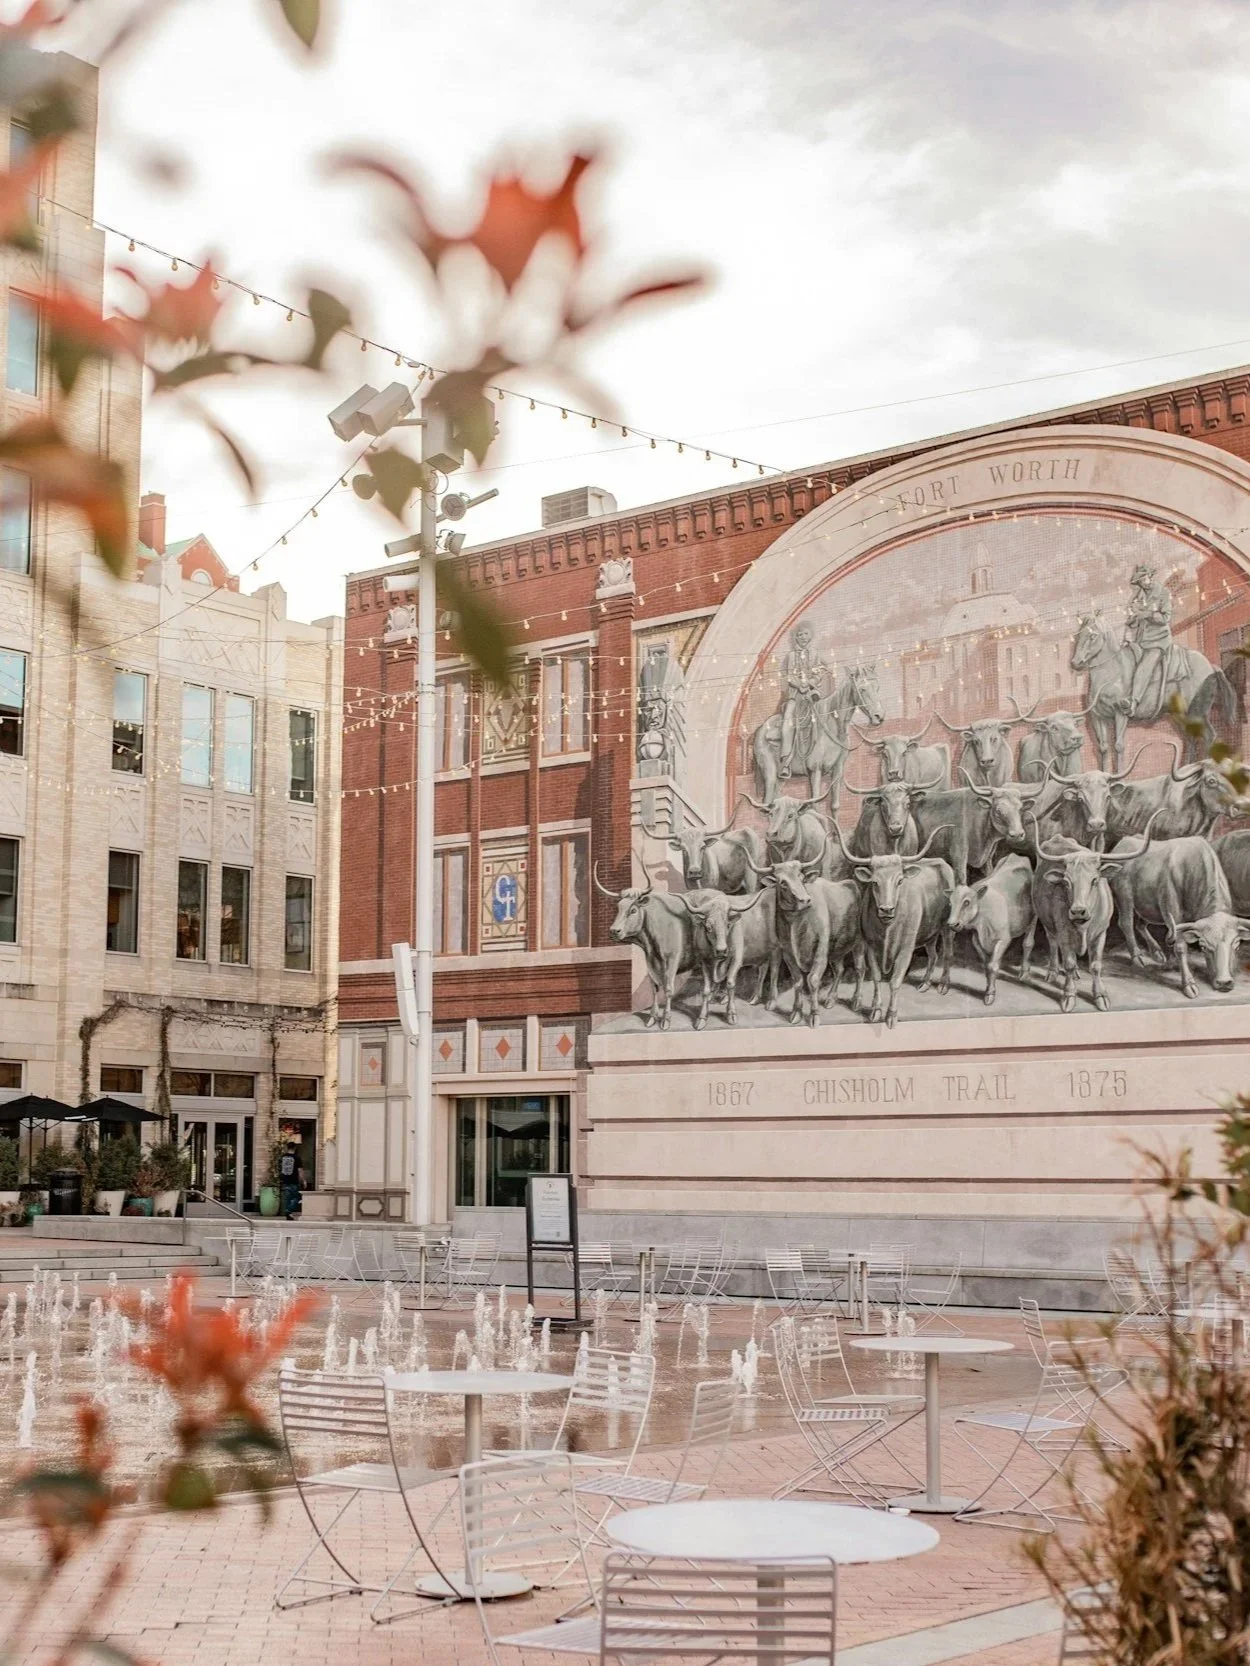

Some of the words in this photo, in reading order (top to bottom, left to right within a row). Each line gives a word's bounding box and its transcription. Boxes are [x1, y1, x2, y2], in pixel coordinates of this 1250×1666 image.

[897, 475, 960, 511] FORT
[989, 458, 1081, 486] WORTH
[708, 1081, 754, 1107] 1867
[803, 1077, 914, 1105] CHISHOLM
[943, 1074, 1016, 1101] TRAIL
[1068, 1070, 1127, 1099] 1875
